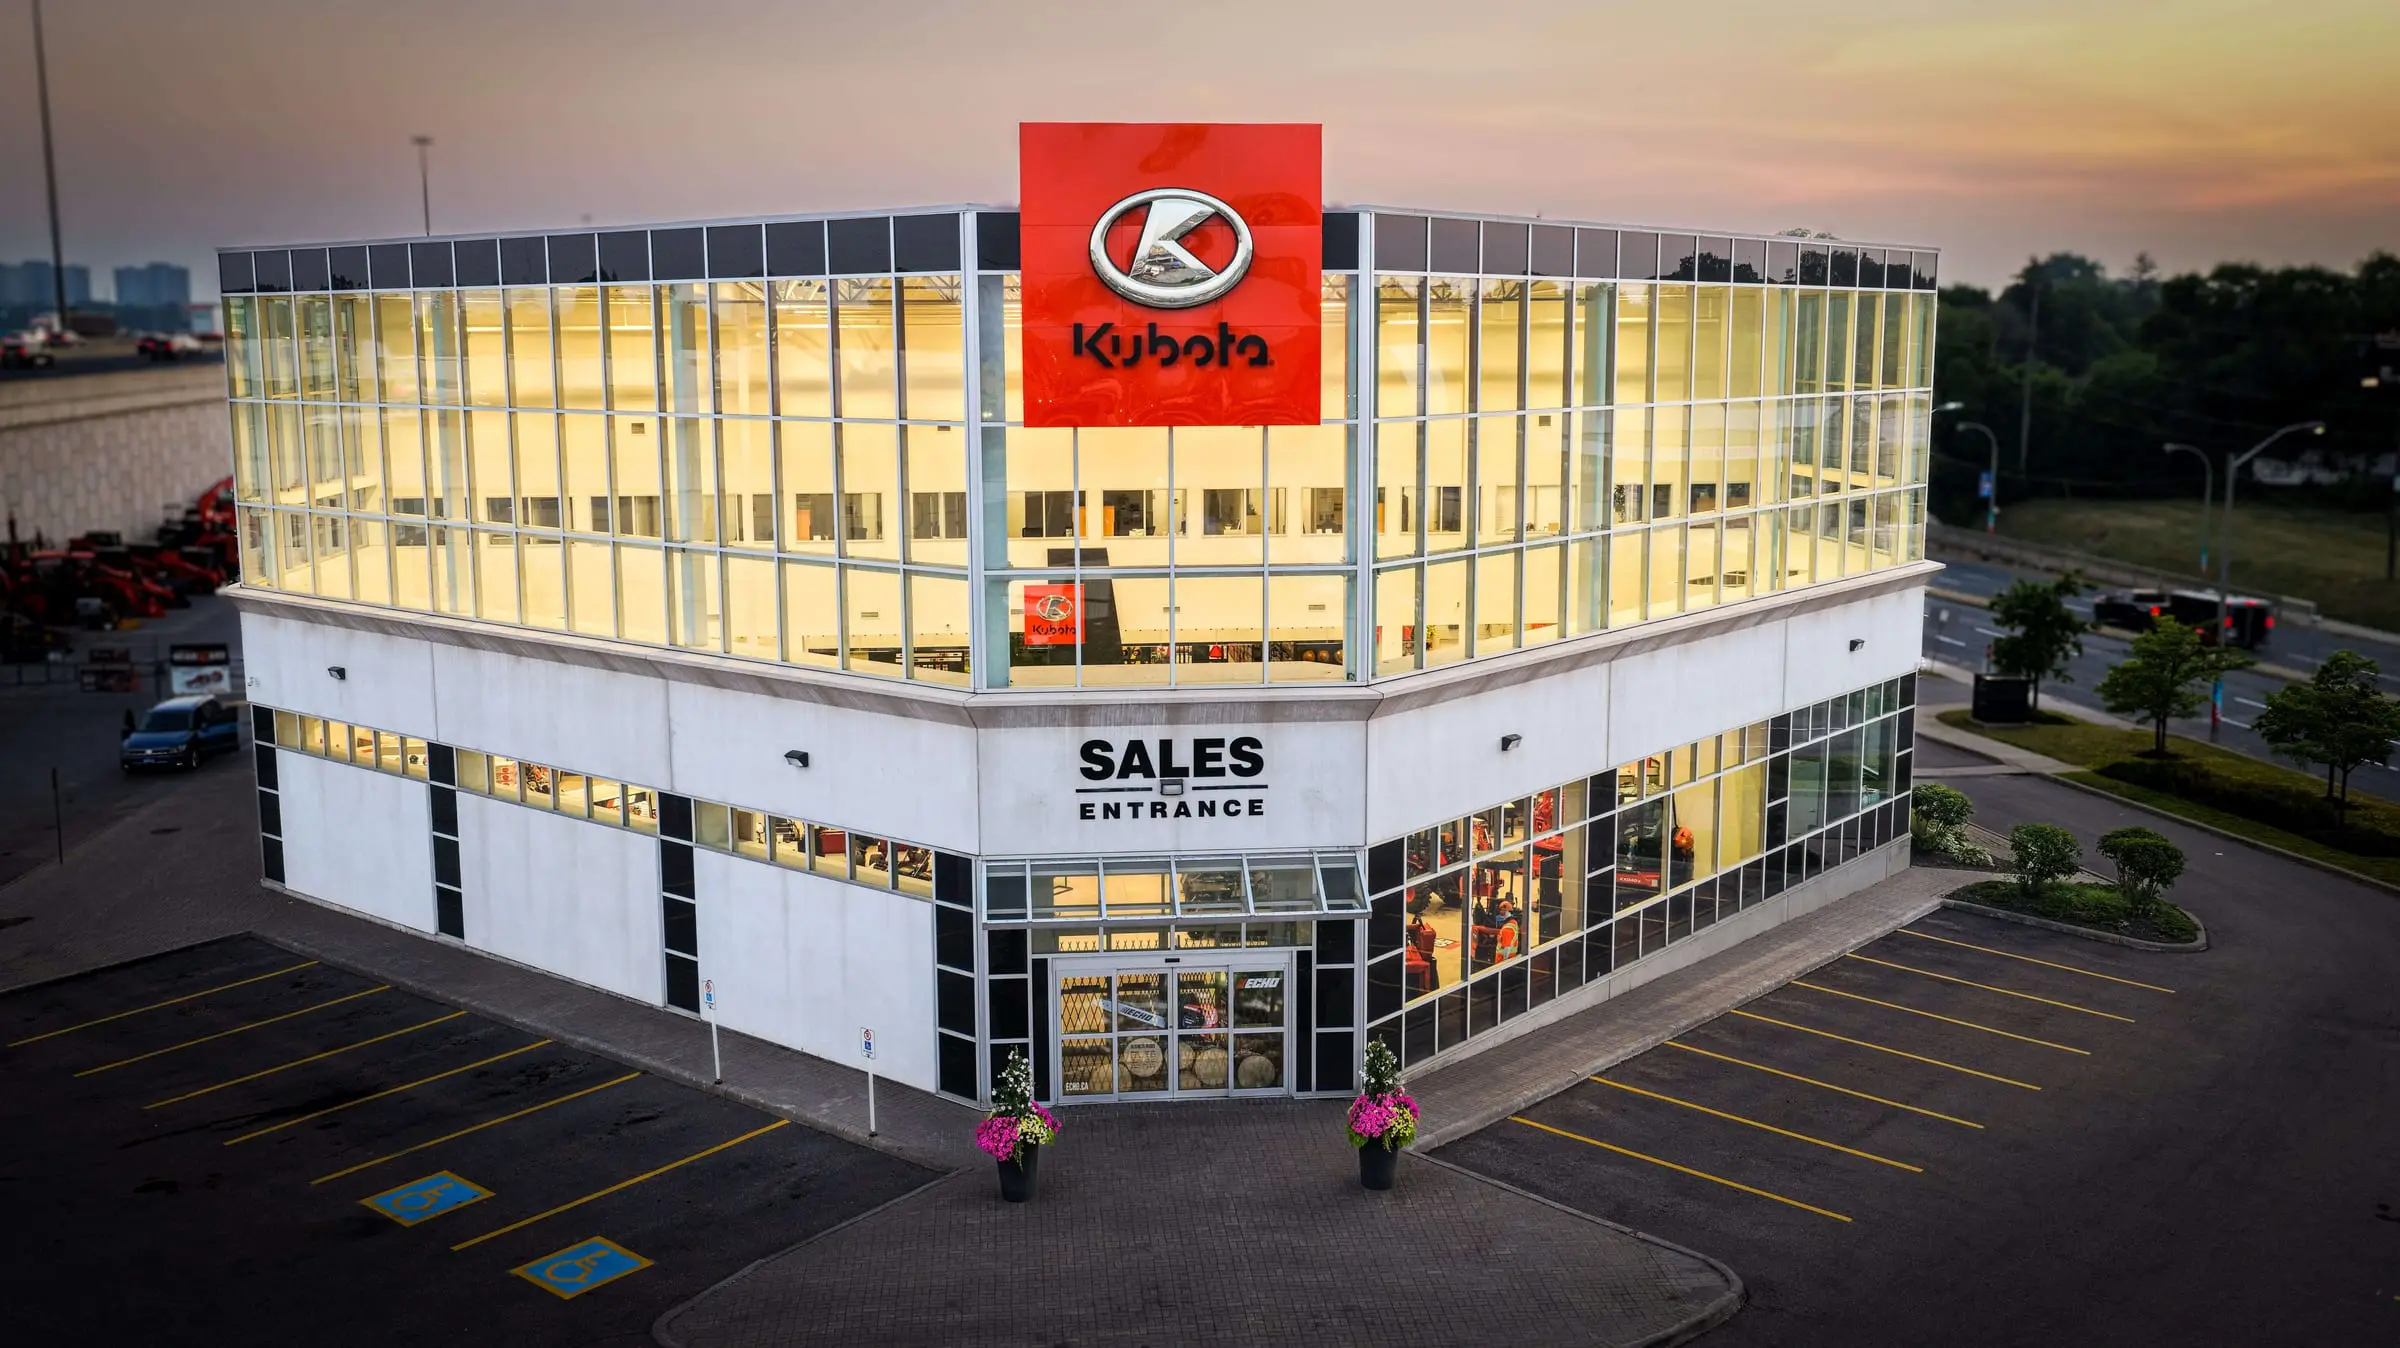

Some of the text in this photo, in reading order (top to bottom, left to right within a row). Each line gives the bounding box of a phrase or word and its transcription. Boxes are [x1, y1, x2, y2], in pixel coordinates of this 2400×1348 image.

[1073, 322, 1269, 368] Kubota
[1032, 624, 1076, 636] Kubota
[1079, 736, 1265, 781] SALES
[1079, 798, 1265, 820] ENTRANCE
[1245, 977, 1280, 989] ECHO
[1127, 1007, 1154, 1022] ECHO
